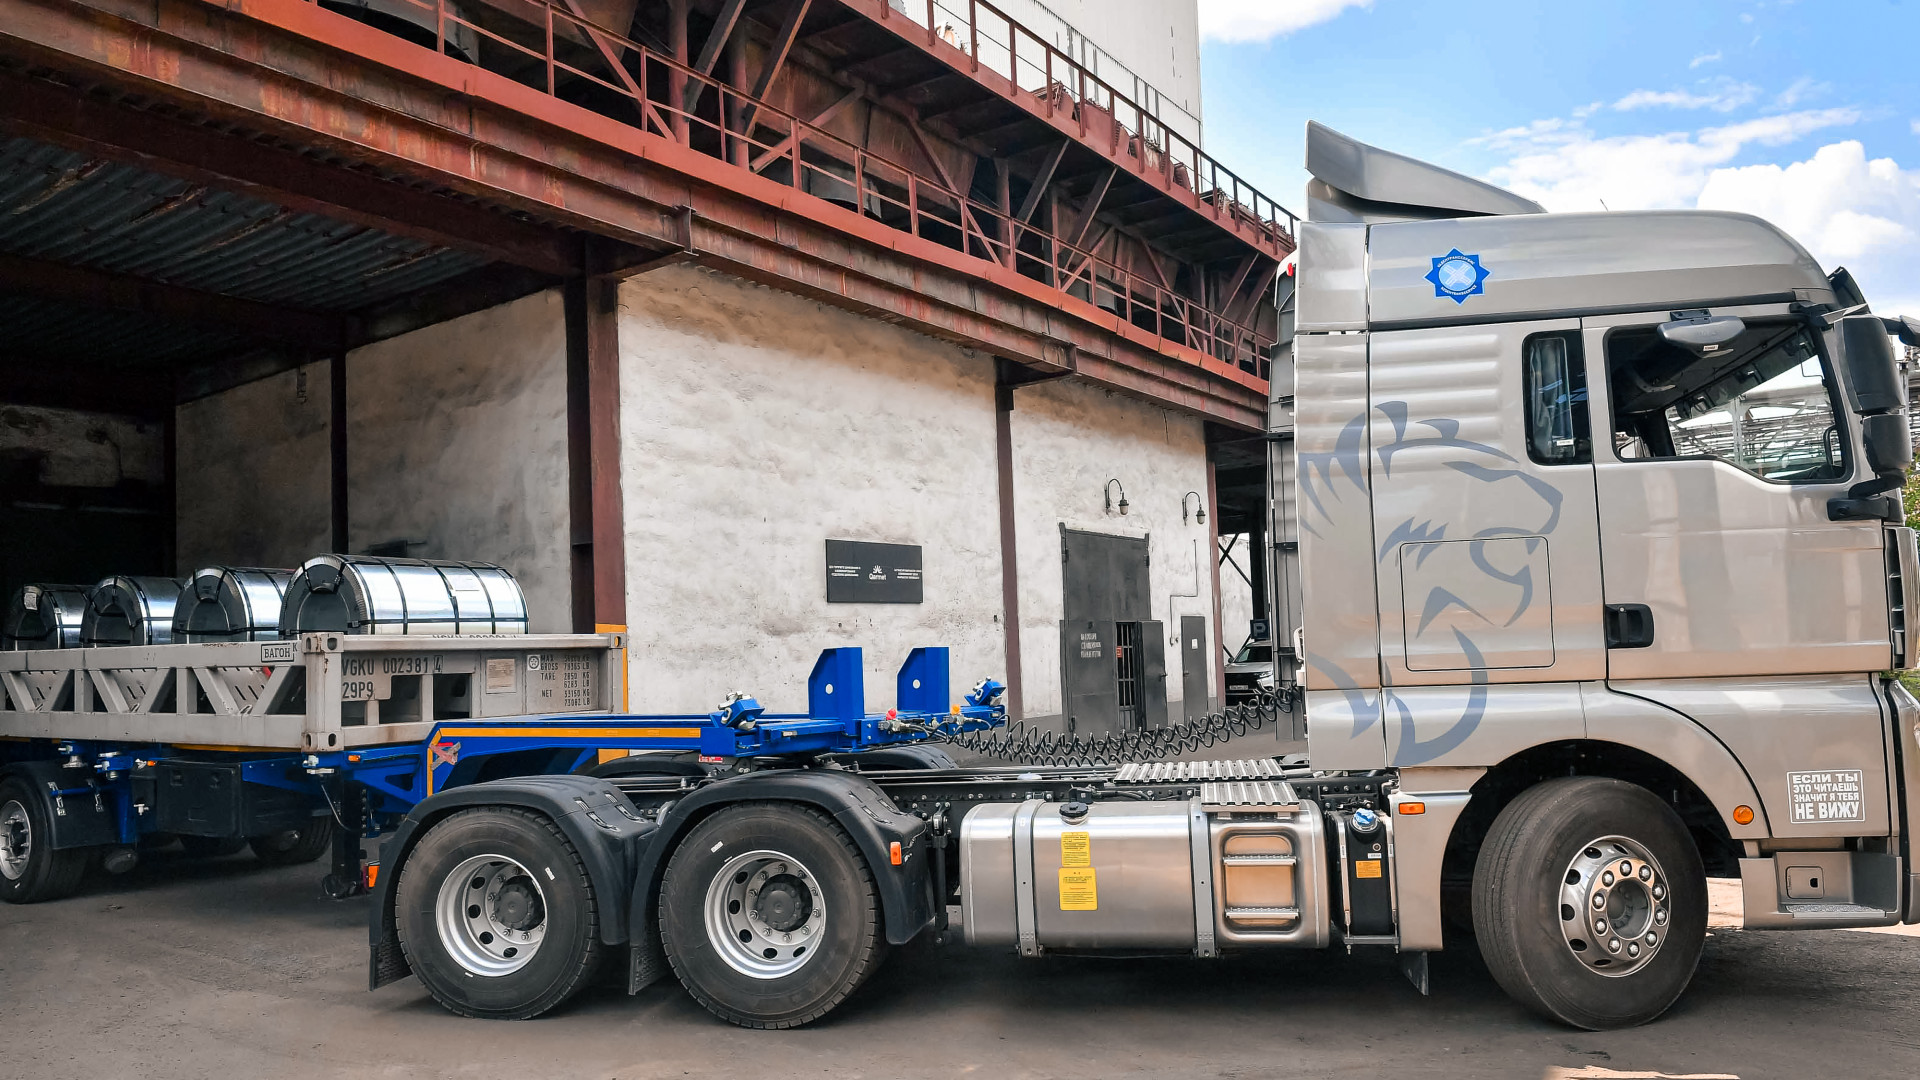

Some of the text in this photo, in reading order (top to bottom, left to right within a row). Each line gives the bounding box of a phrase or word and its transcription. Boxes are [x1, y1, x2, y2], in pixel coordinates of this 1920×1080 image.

[1253, 623, 1266, 637] P
[264, 648, 290, 658] ВАГОН
[341, 658, 374, 676] VGKU
[383, 657, 428, 674] 002381
[541, 662, 558, 671] GROSS
[541, 672, 556, 680] TARE
[583, 671, 590, 679] KG
[342, 681, 374, 699] 29P9
[541, 690, 552, 698] NET
[583, 697, 590, 706] LB
[1792, 773, 1858, 784] ЕСЛИ ТЫ
[1793, 782, 1859, 793] ЭТО ЧИТАЕШЬ
[1794, 792, 1859, 803] ЗНАЧИТ Я ТЕБЯ
[1794, 801, 1860, 820] НЕ ВИЖУ
